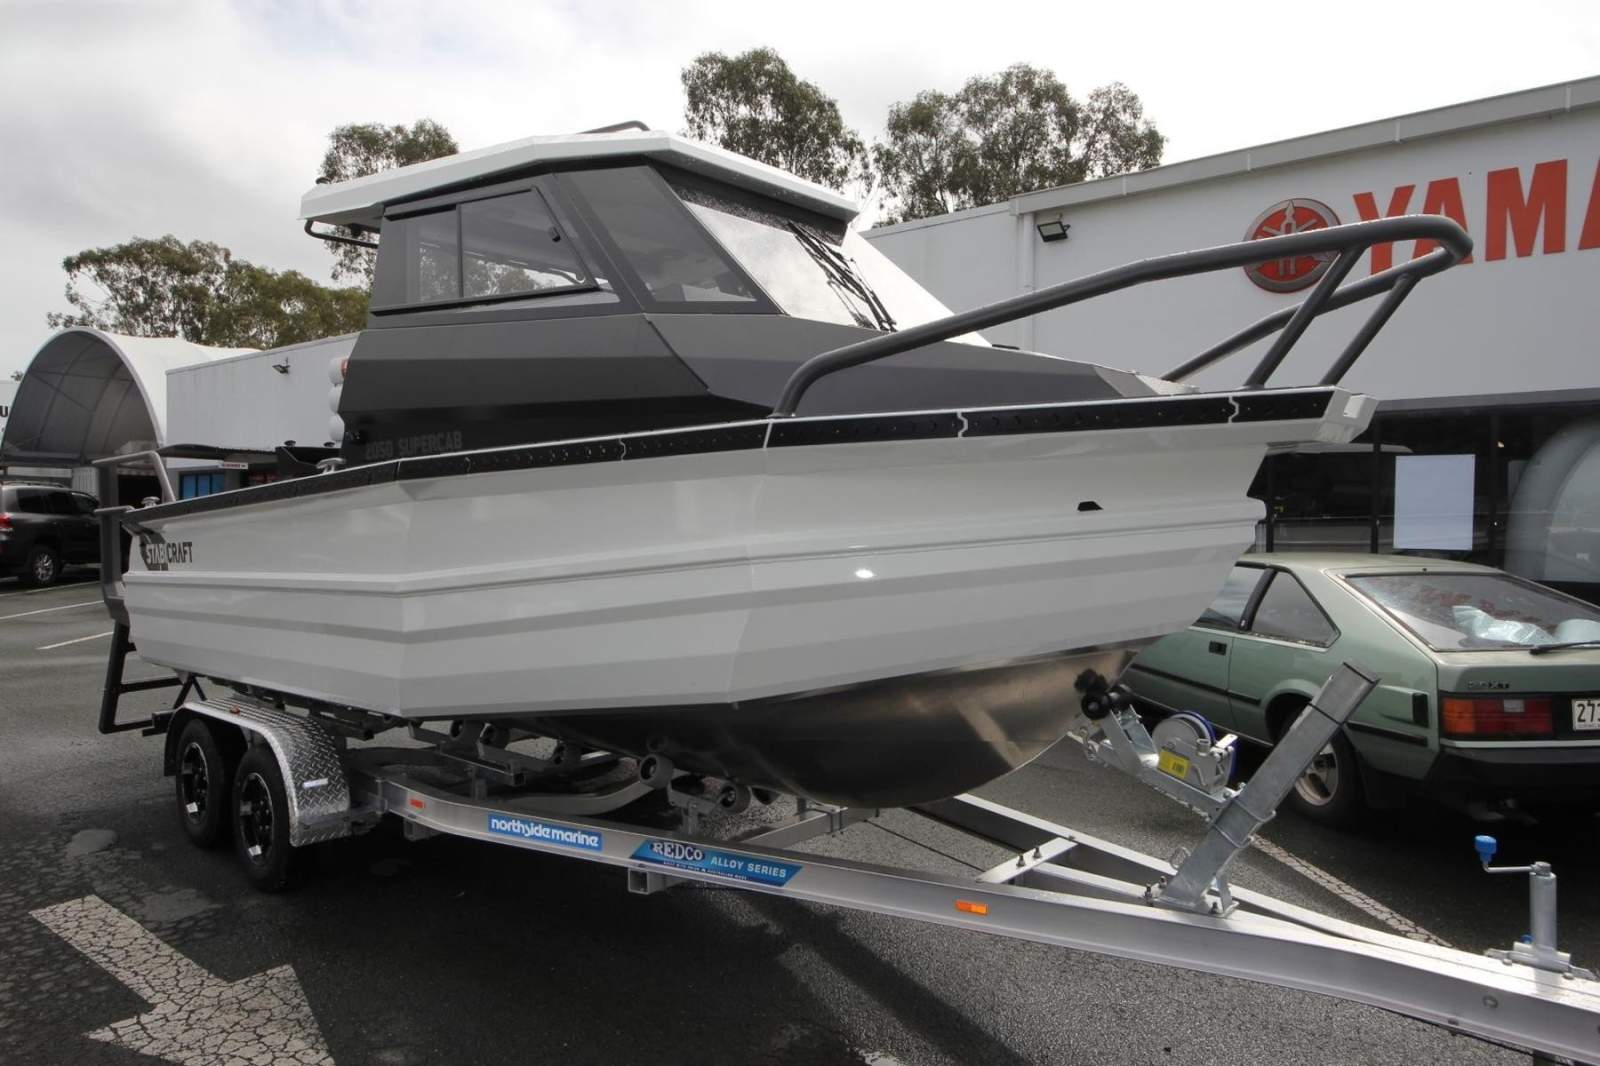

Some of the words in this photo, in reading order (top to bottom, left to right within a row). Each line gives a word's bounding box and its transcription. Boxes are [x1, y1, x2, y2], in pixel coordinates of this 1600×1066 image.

[398, 430, 462, 456] SUPERCAB
[491, 818, 550, 838] northside
[552, 828, 599, 847] marine
[710, 856, 744, 872] ALLOY
[747, 862, 787, 878] SERIES
